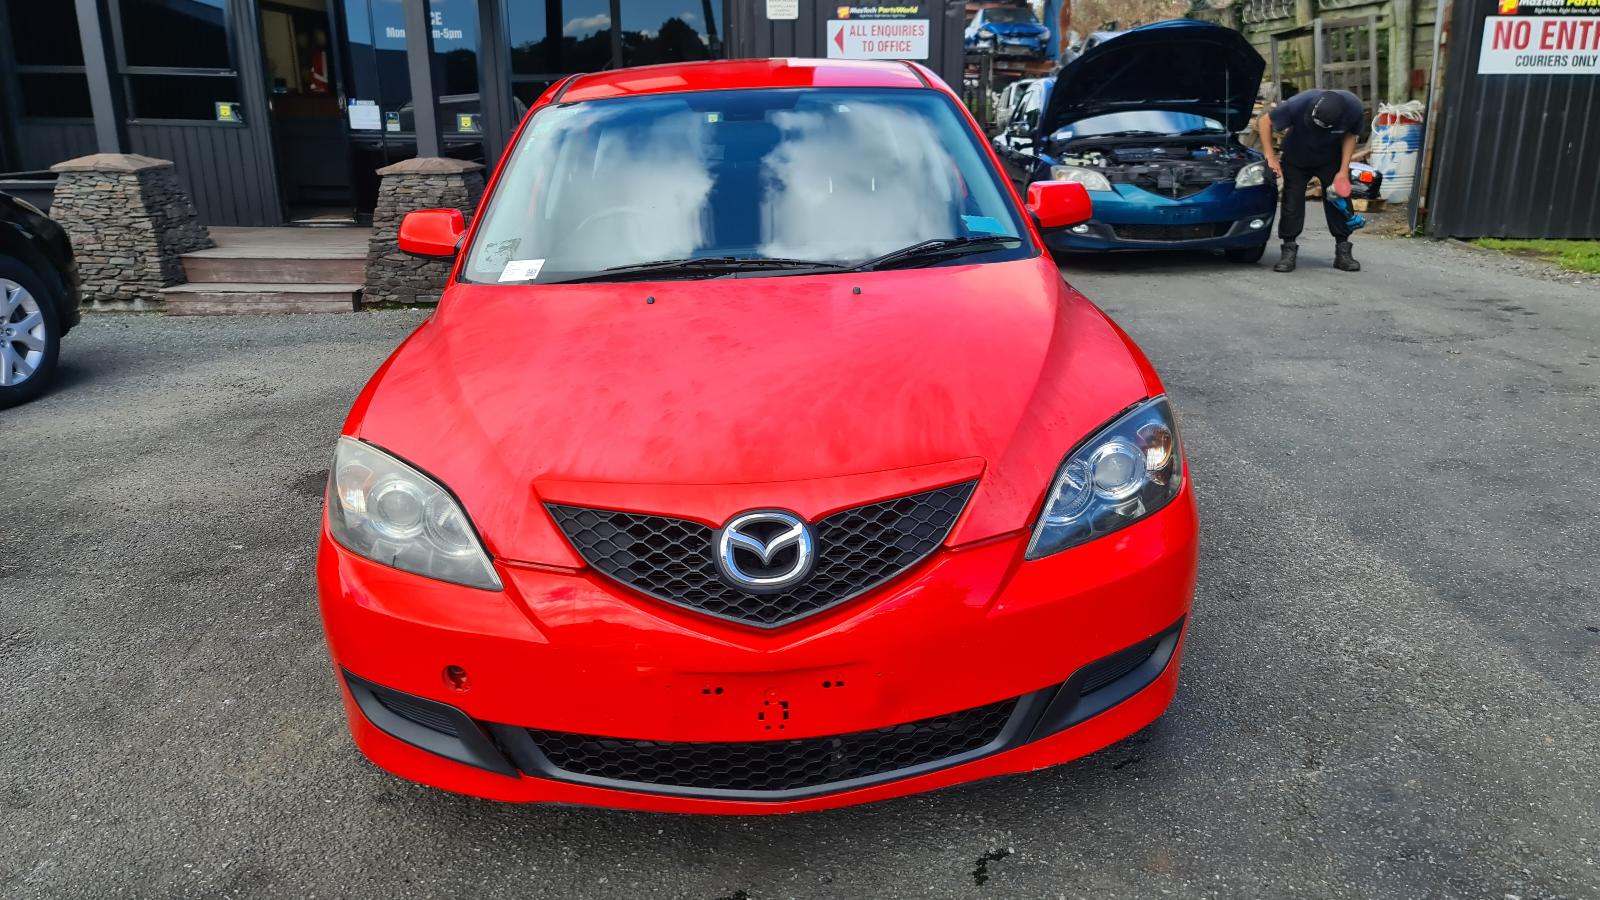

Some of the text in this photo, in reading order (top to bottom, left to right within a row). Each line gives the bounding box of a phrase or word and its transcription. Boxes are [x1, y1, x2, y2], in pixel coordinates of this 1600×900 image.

[431, 28, 463, 40] m-5pm
[850, 25, 925, 37] ALL ENQUIRIES
[1492, 20, 1531, 51] NO
[862, 41, 912, 52] TO OFFICE
[1515, 55, 1599, 67] COURIERS ONLY
